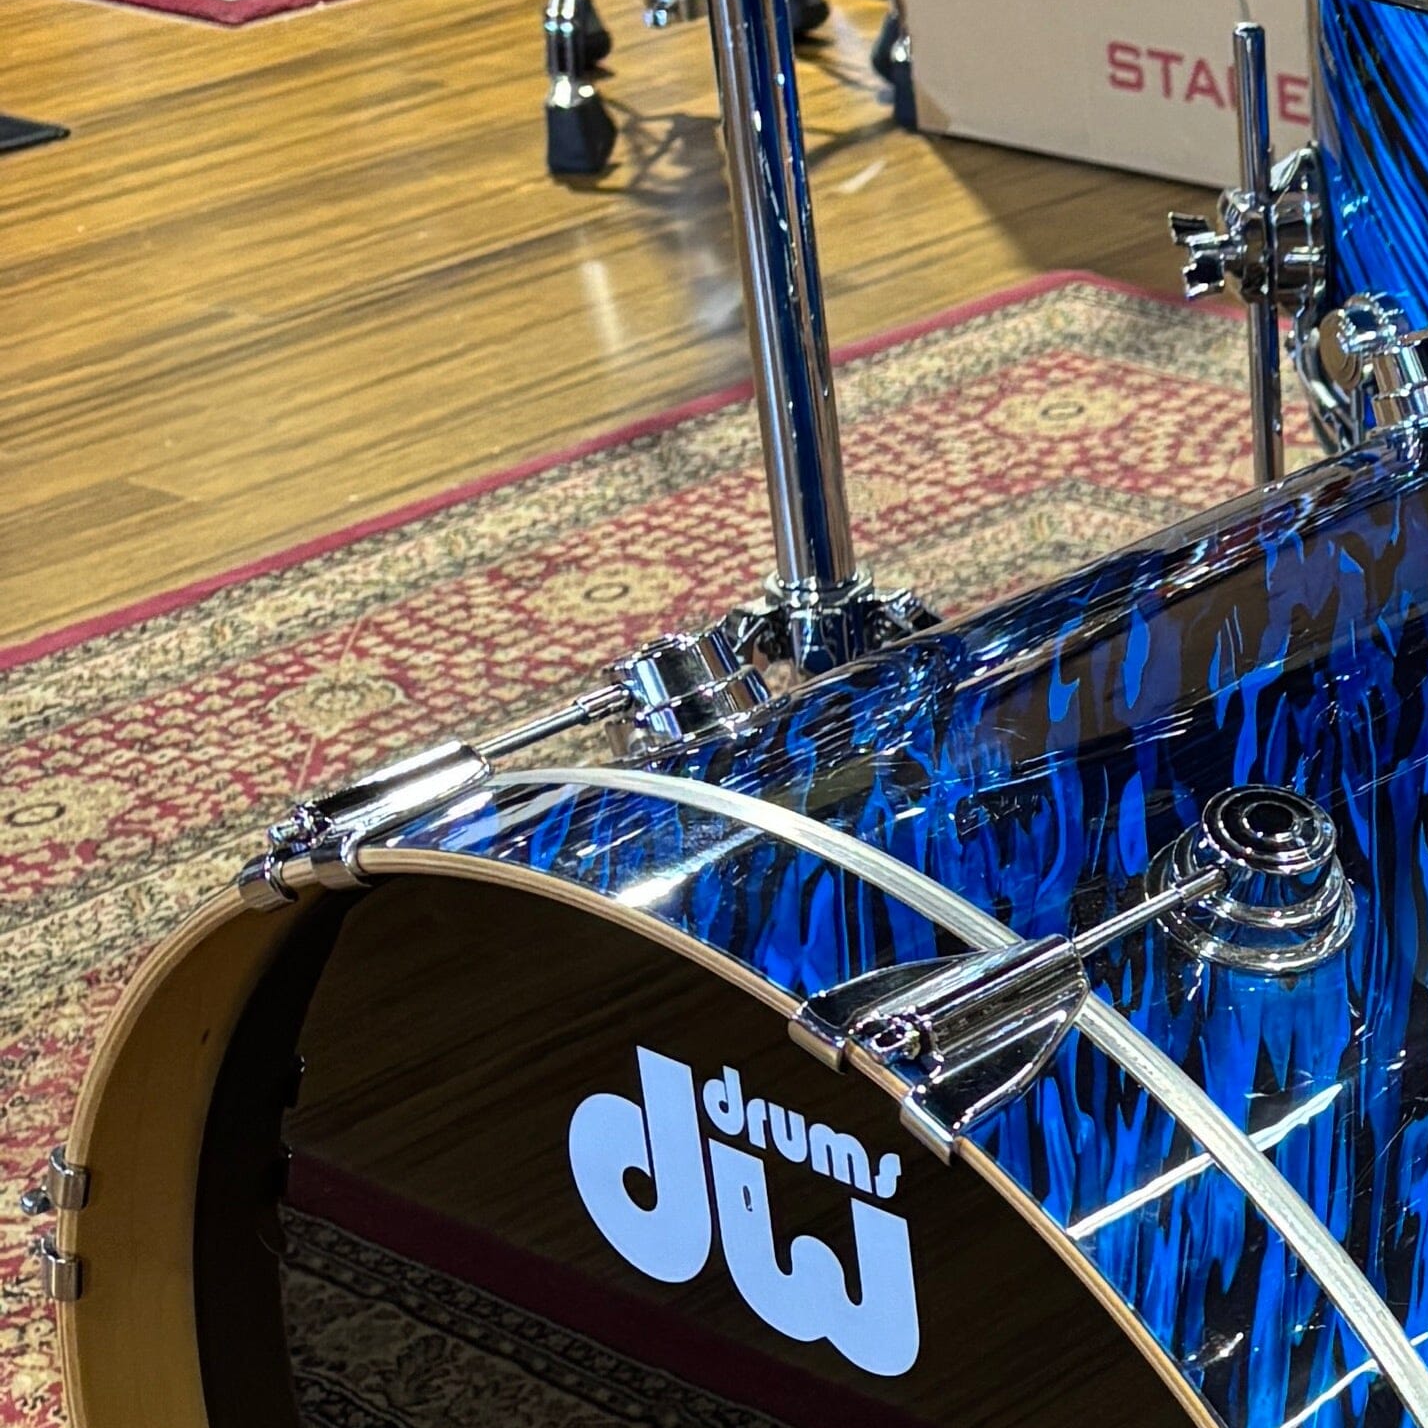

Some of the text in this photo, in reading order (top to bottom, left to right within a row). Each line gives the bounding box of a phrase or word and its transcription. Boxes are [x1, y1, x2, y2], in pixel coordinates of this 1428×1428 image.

[1107, 41, 1312, 126] STAE
[703, 1065, 902, 1199] drums
[568, 1045, 920, 1377] dw
